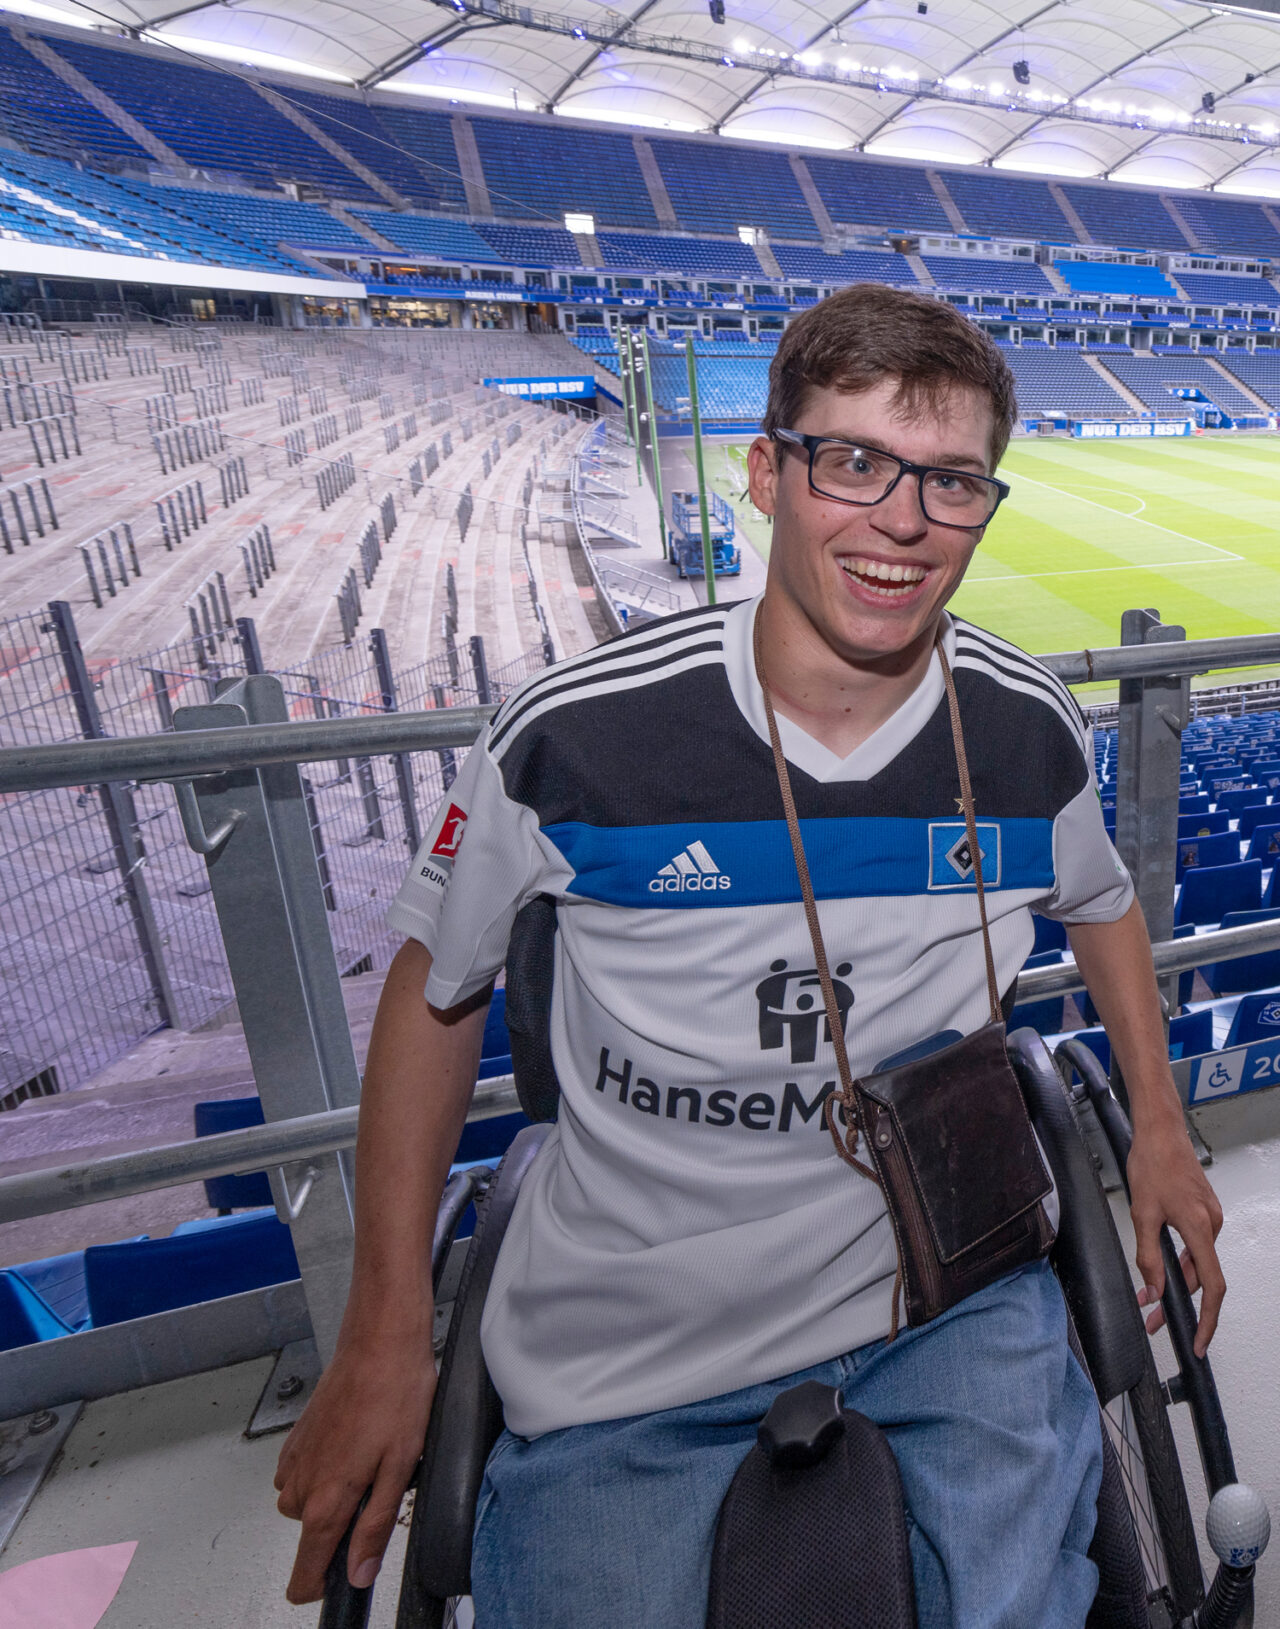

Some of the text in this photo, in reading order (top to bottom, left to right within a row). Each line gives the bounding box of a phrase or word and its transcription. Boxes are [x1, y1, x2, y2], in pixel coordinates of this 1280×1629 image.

[530, 382, 557, 394] DER
[558, 381, 584, 392] HSV
[1082, 423, 1186, 436] NUR DER HSV
[648, 873, 731, 893] adidas
[595, 1046, 848, 1132] HanseM
